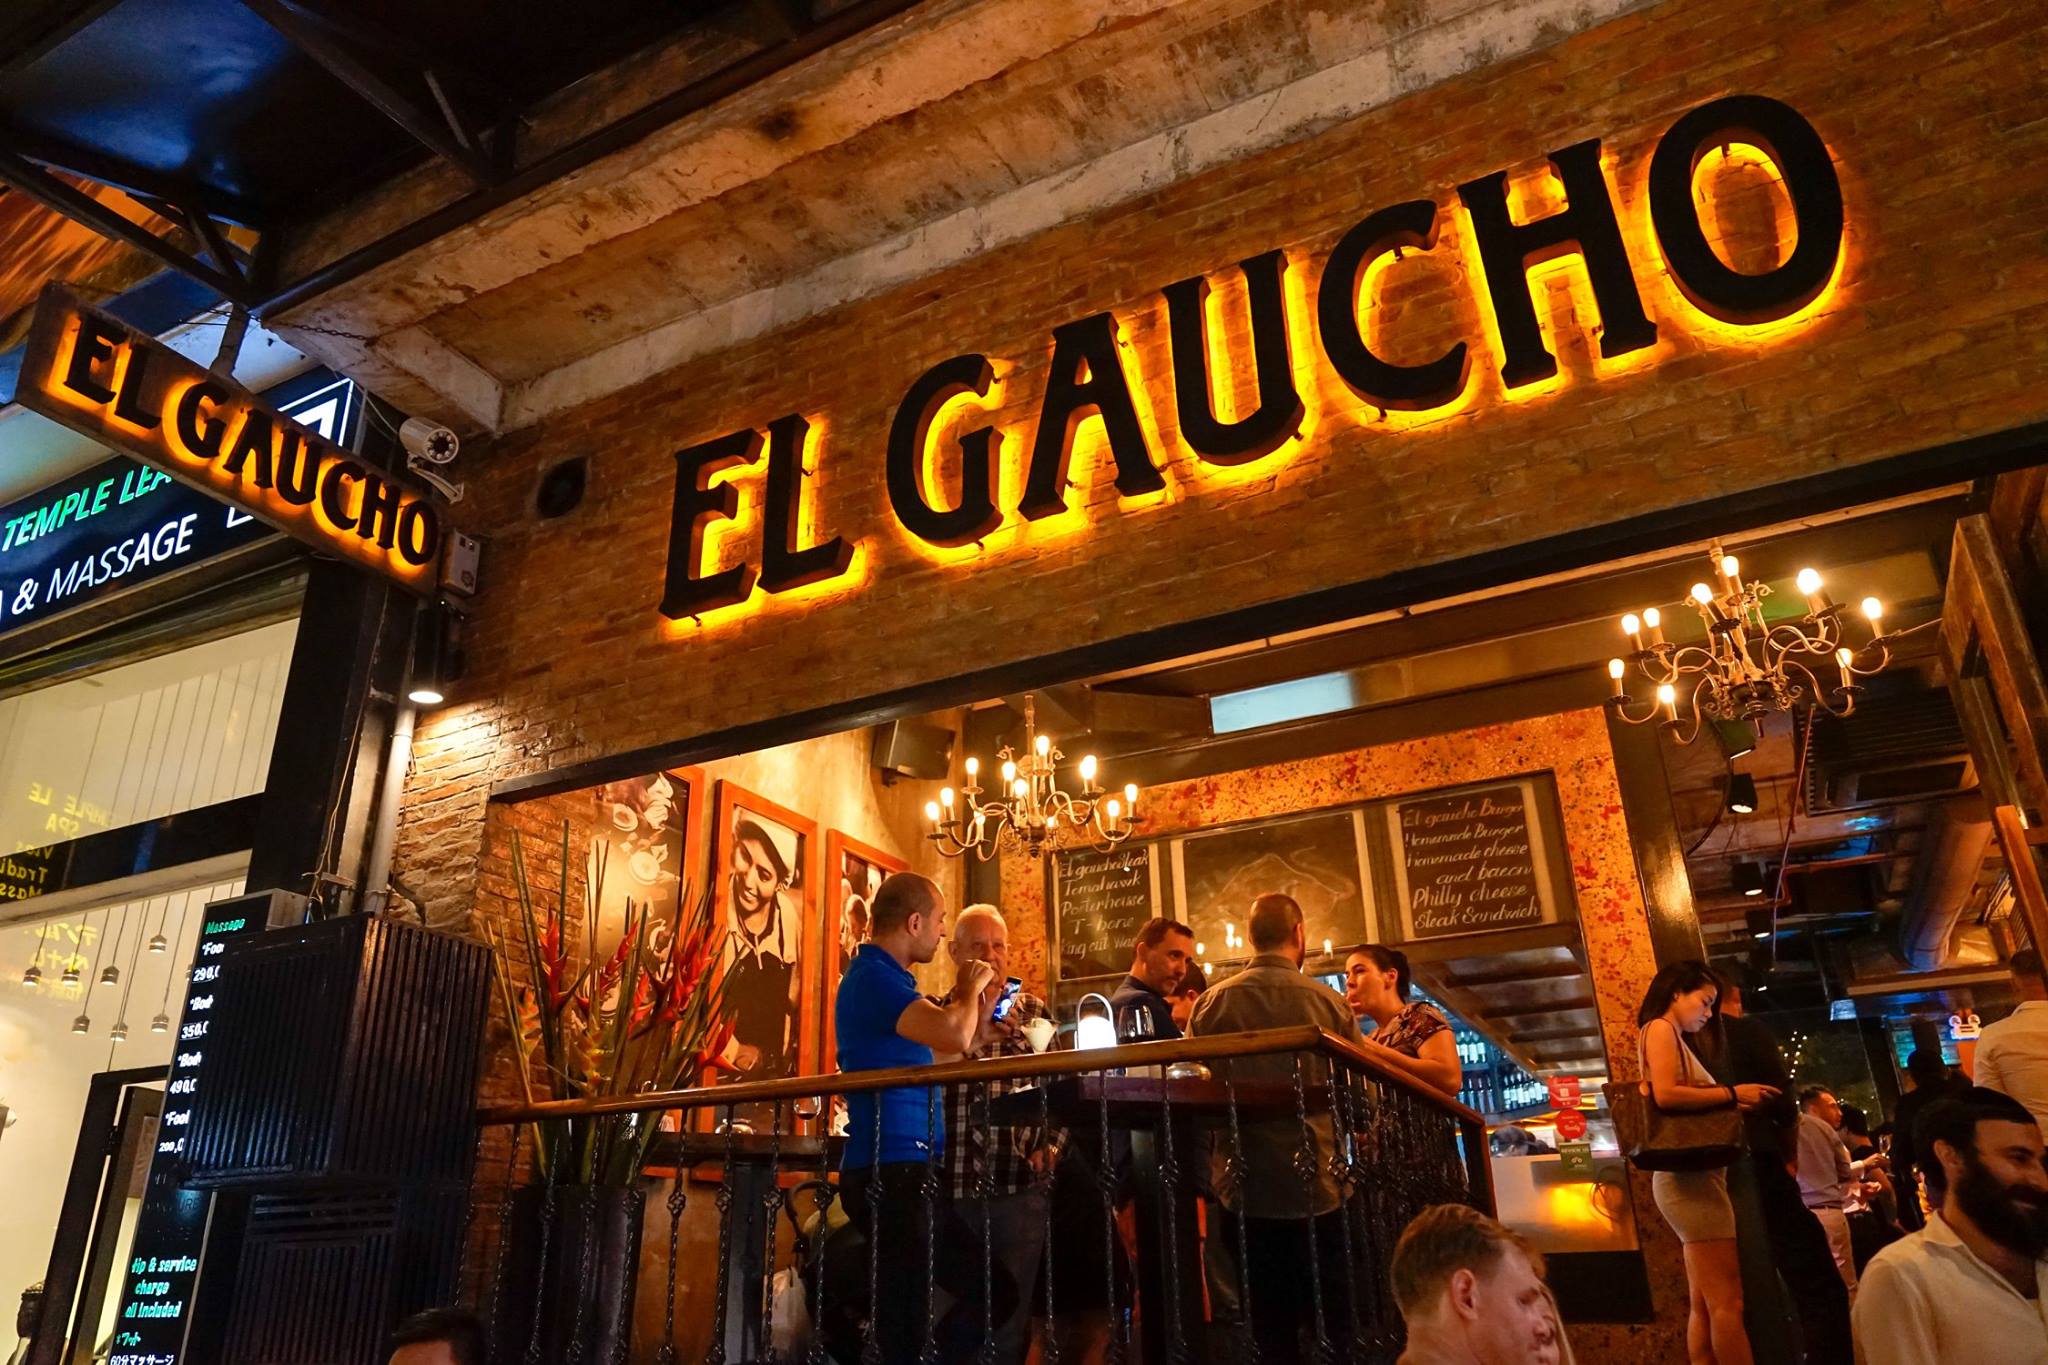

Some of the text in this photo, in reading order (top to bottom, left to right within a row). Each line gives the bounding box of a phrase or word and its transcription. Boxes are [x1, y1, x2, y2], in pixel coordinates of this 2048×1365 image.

[659, 94, 1846, 620] EL GAUCHO
[64, 314, 438, 565] EL GAUCHO
[2, 480, 114, 551] TEMPLE
[11, 578, 39, 615] &
[46, 513, 197, 602] MASSAGE
[1436, 864, 1474, 886] and
[1412, 881, 1528, 910] Philly cheese
[147, 1258, 157, 1273] &
[157, 1255, 198, 1273] service
[135, 1279, 170, 1297] charge
[137, 1301, 183, 1318] included
